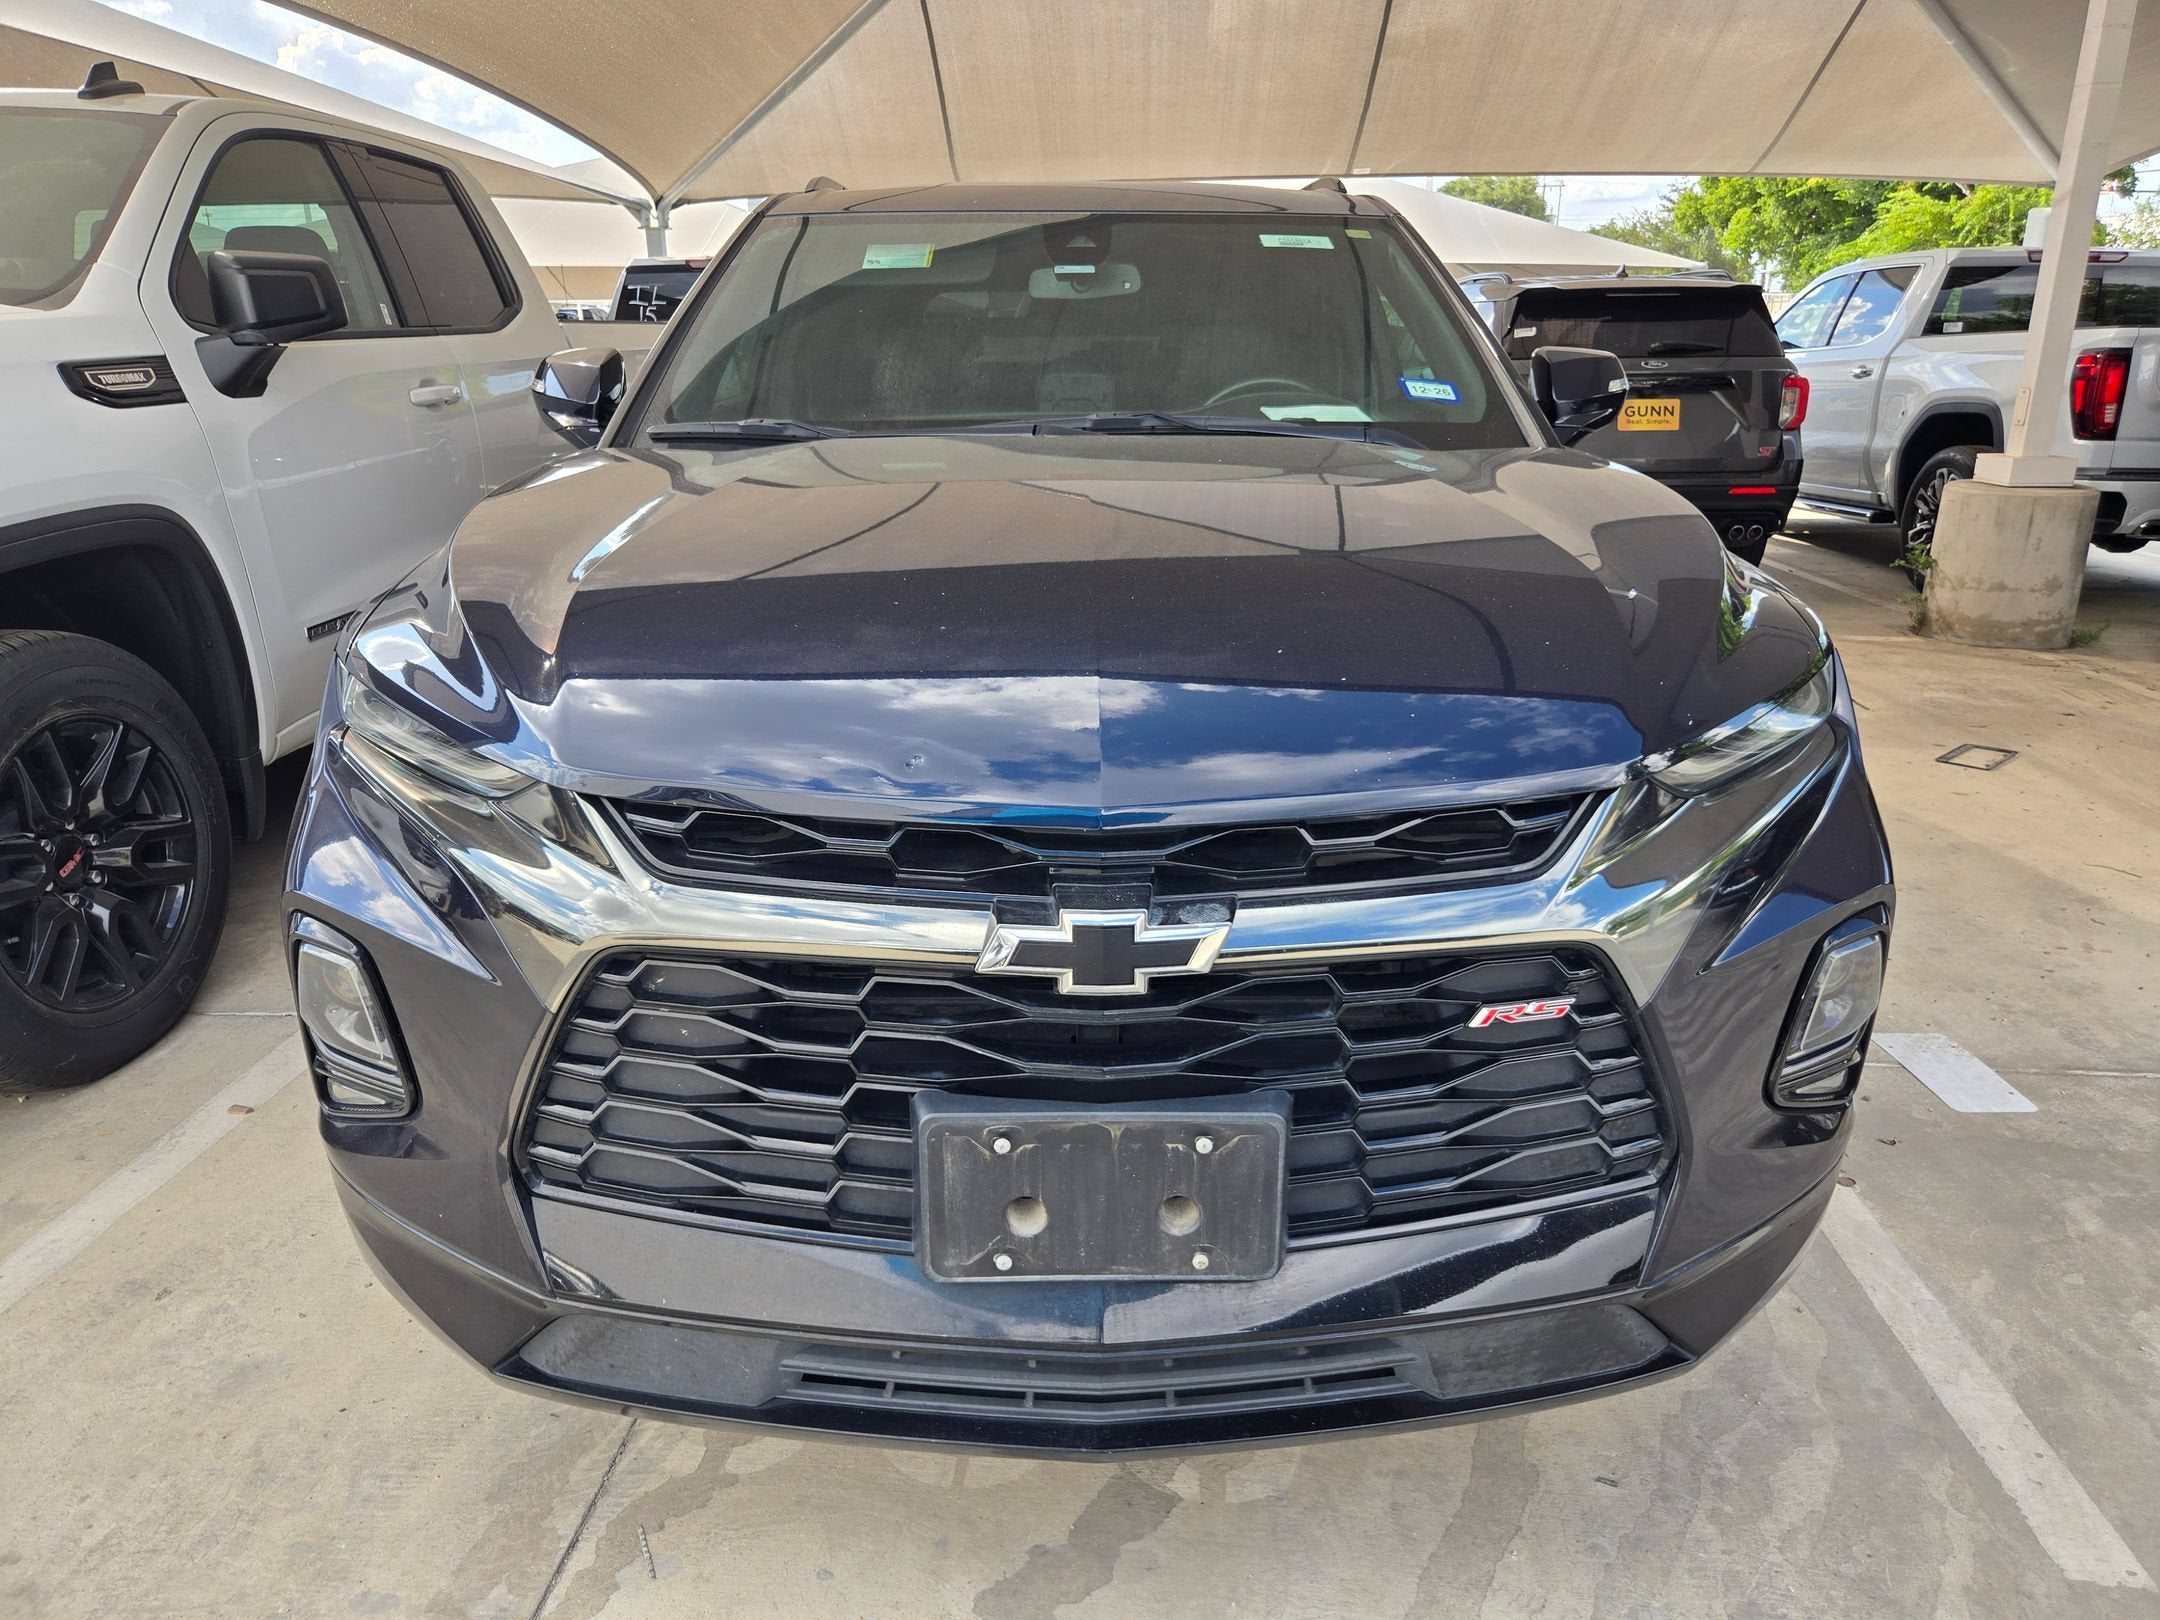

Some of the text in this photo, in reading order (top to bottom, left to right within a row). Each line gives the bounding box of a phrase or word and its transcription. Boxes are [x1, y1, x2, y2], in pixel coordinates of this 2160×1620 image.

[1624, 405, 1675, 418] GUNN
[1645, 418, 1672, 426] Simple.
[1468, 998, 1576, 1028] RS
